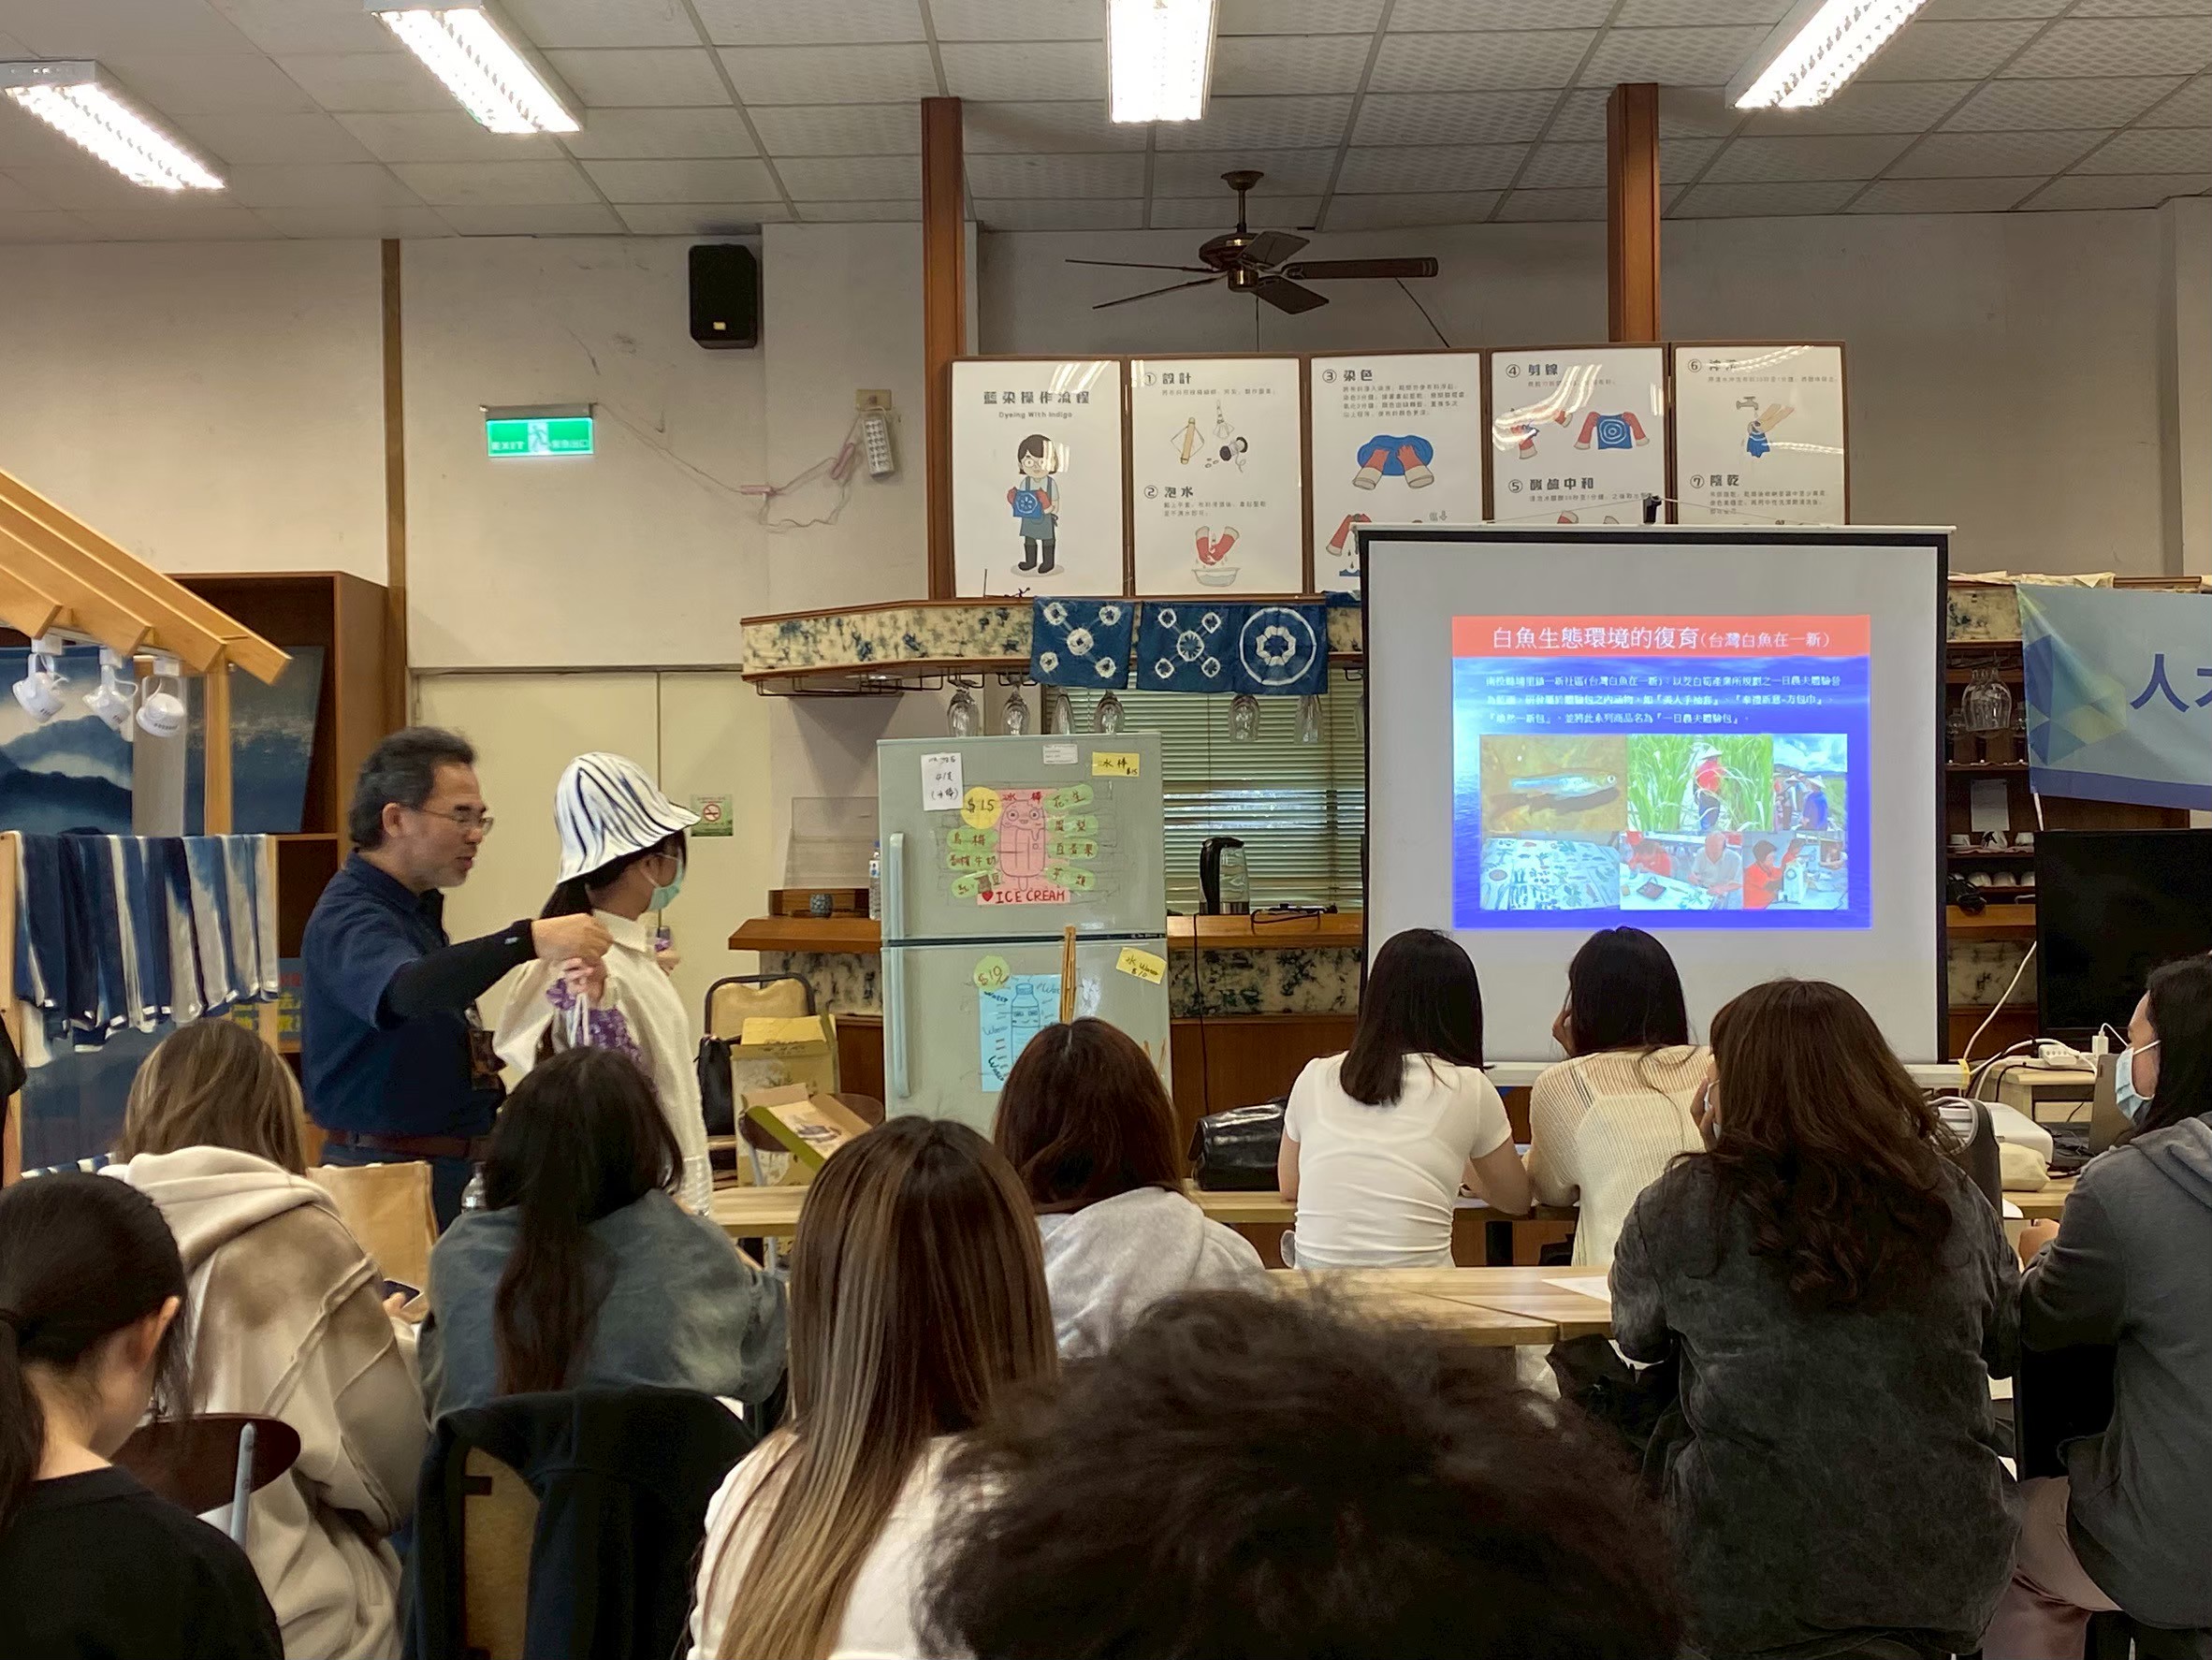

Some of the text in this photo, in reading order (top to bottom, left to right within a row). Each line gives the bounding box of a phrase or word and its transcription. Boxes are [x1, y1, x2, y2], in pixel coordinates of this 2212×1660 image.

[1161, 372, 1192, 385] 設計
[1343, 370, 1373, 382] 染色
[983, 390, 1089, 405] 藍染操作流程
[491, 441, 524, 450] EXIT
[1530, 477, 1594, 490] 酸鹼中和
[1710, 474, 1739, 487] 陰乾
[1164, 486, 1194, 498] 泡水
[996, 889, 1065, 904] ICE CREAM
